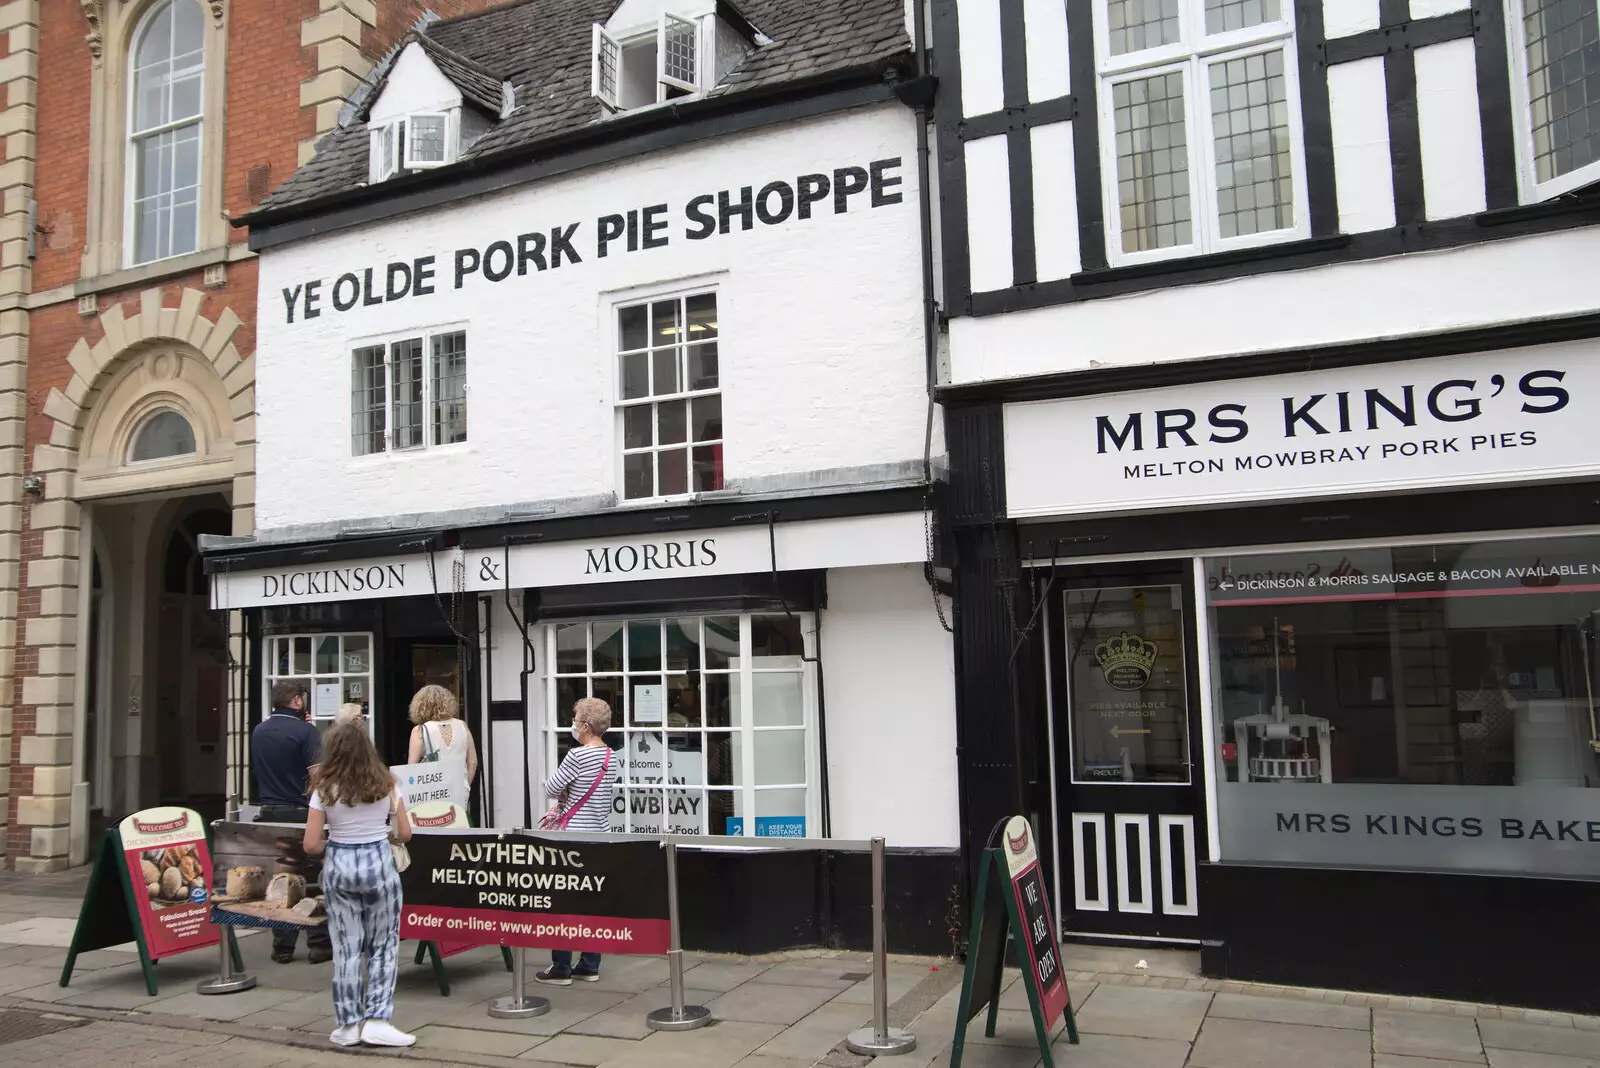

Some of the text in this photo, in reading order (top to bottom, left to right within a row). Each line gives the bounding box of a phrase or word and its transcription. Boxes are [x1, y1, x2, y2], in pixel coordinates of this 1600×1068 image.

[281, 156, 903, 324] YE OLDE PORK PIE SHOPPE
[1095, 369, 1571, 454] MRS KING'S
[1123, 430, 1538, 479] MELTON MOWBRAY PORK PIES
[262, 538, 718, 598] DICKINSON & MORRIS
[1237, 577, 1304, 590] DICKINSON
[1308, 576, 1318, 586] &
[1320, 574, 1369, 586] MORRIS
[1372, 571, 1435, 584] SAUSAGE
[1438, 571, 1448, 581] &
[1450, 568, 1502, 581] BACON
[1505, 564, 1588, 579] AVAILABLE
[416, 772, 443, 785] PLEASE
[408, 789, 450, 804] WAIT HERE.
[140, 822, 173, 832] WELCOME
[418, 817, 445, 826] WELCOME
[676, 826, 700, 834] Food
[1276, 812, 1352, 834] MRS
[1366, 814, 1483, 838] KINGS
[450, 843, 584, 868] AUTHENTIC
[432, 868, 606, 892] MELTON MOWBRAY
[478, 892, 552, 909] PORK PIES
[1025, 881, 1038, 908] WE
[160, 906, 207, 922] Fabulous Bread
[407, 913, 633, 942] Order on-line: www.porkpie.co.uk
[1032, 915, 1047, 945] ARE
[1038, 947, 1056, 983] OPEN
